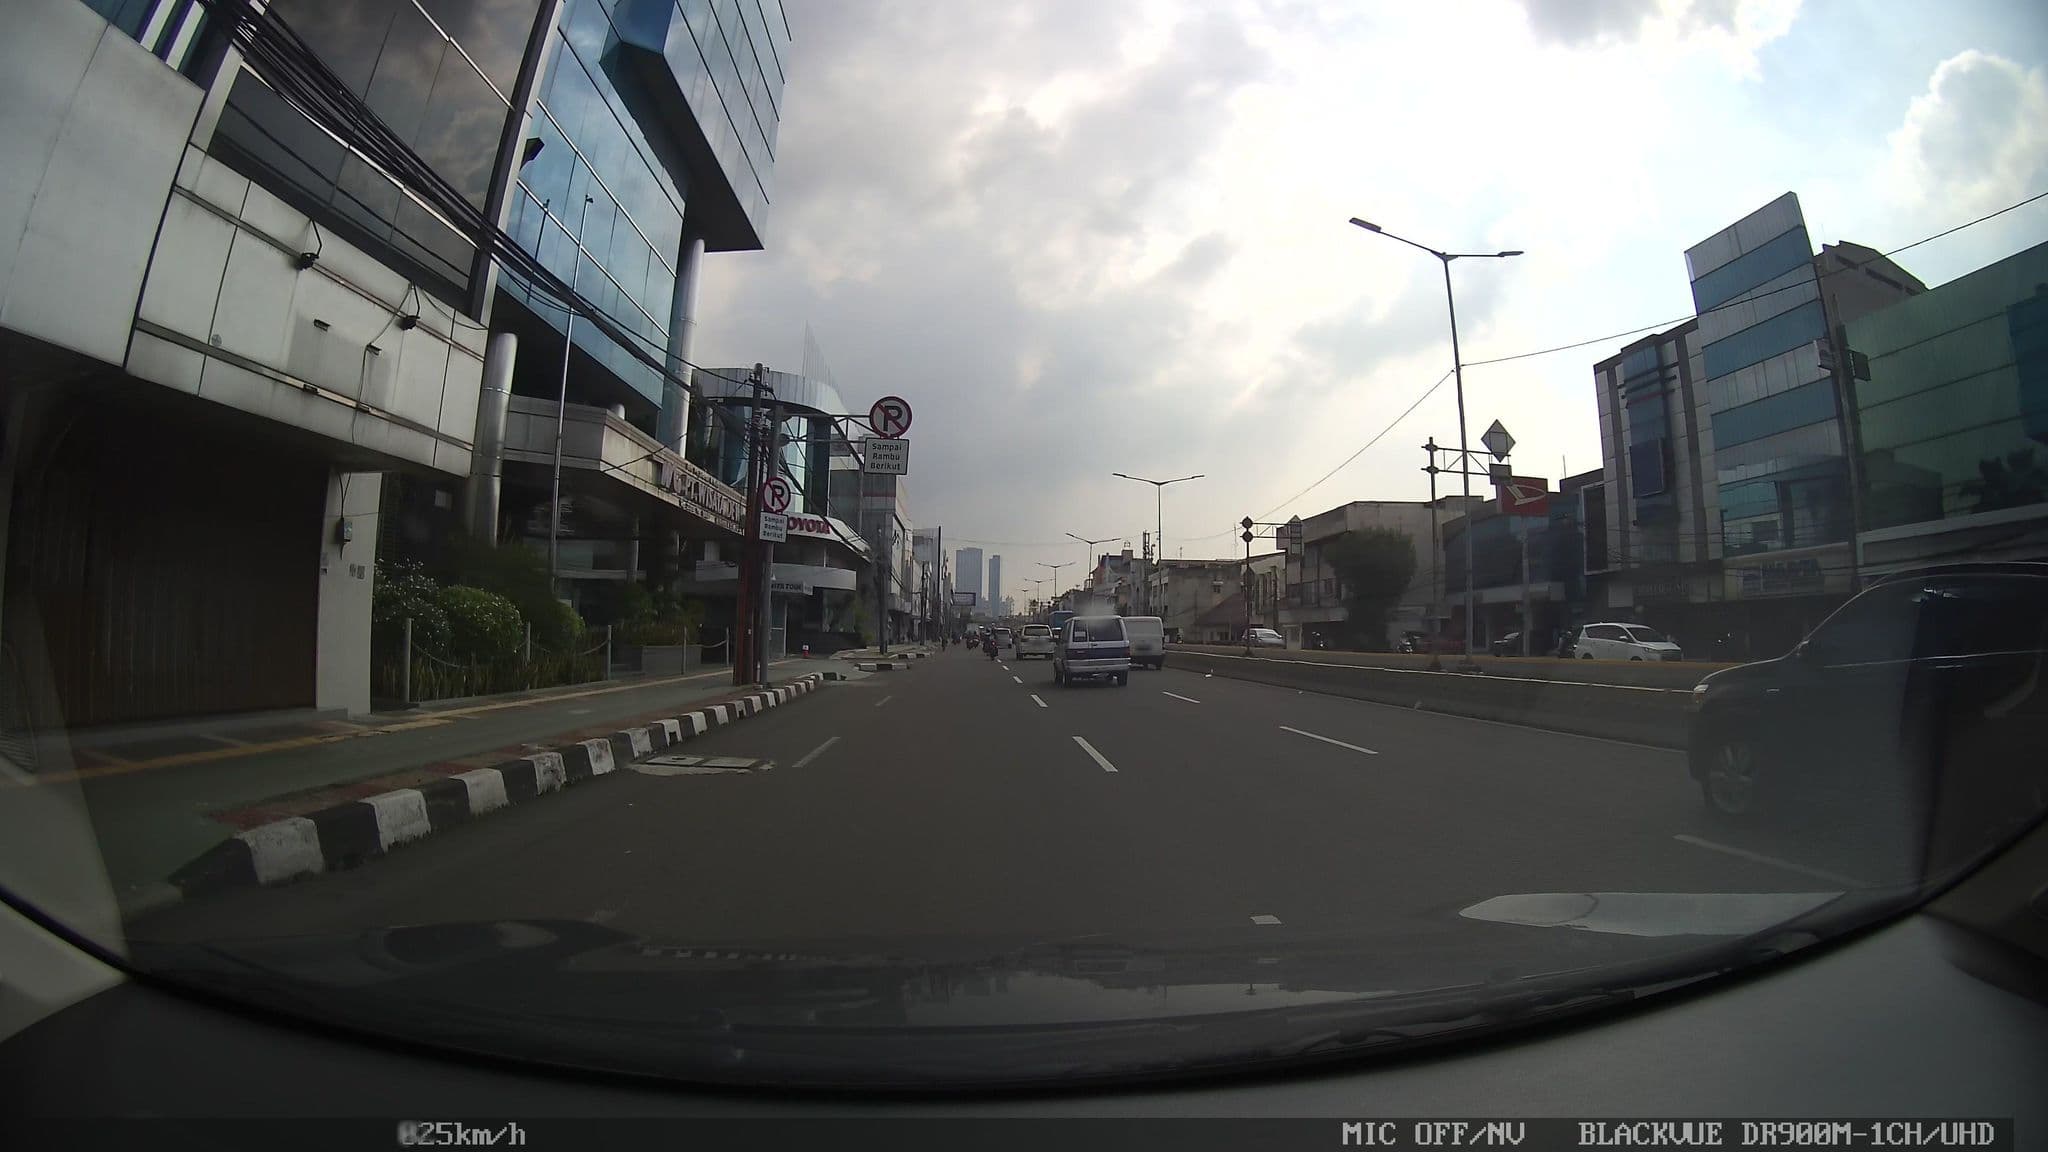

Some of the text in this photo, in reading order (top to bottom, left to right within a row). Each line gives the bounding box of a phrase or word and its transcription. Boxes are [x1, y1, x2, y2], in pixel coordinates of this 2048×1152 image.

[883, 405, 903, 431] P
[872, 443, 902, 452] Sampai
[873, 453, 901, 461] Rambu
[870, 462, 901, 471] Berikut
[772, 485, 785, 506] P
[787, 516, 831, 534] OYOTA
